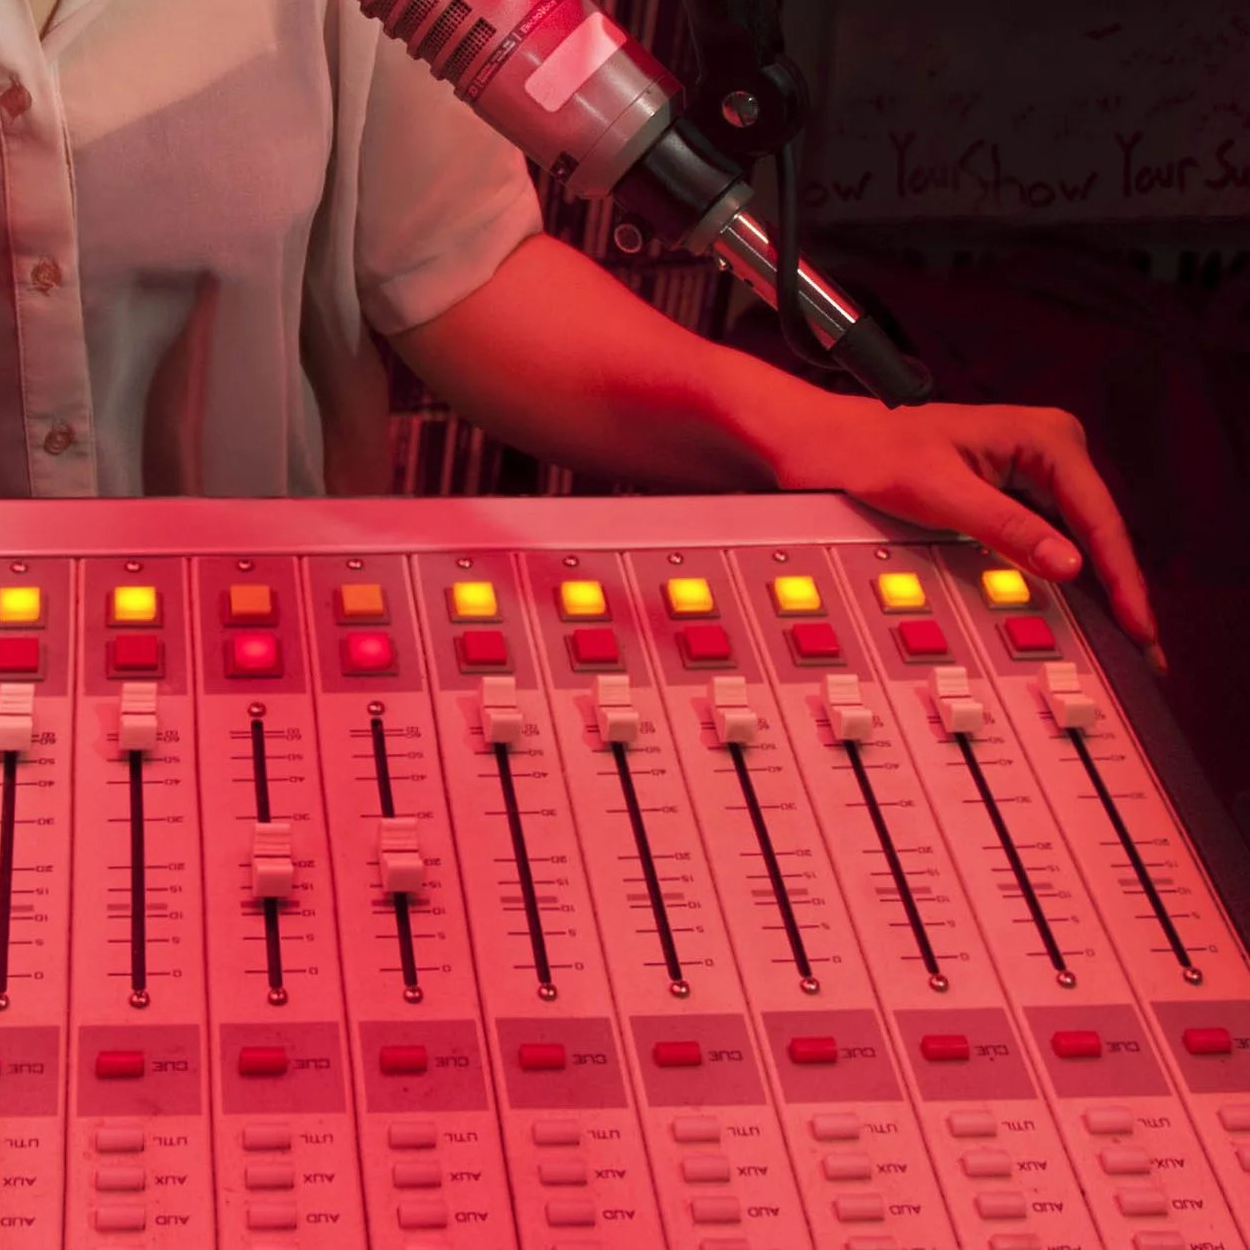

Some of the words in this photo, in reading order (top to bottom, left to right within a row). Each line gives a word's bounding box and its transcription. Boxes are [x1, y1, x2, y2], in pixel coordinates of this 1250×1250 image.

[959, 138, 1098, 208] Show
[1115, 131, 1199, 197] Your
[1204, 137, 1250, 188] Su
[974, 1045, 1009, 1056] CUE
[1106, 1041, 1140, 1053] CUE
[708, 1050, 743, 1062] CUE
[840, 1047, 876, 1059] CUE
[293, 1058, 330, 1070] CUE
[435, 1056, 469, 1067] CUE
[572, 1054, 607, 1066] CUE
[8, 1063, 44, 1074] CUE
[152, 1061, 188, 1072] CUE
[1002, 1121, 1035, 1131] UTIL
[1137, 1117, 1171, 1128] UTIL
[727, 1126, 760, 1137] UTIL
[864, 1124, 898, 1134] UTIL
[299, 1134, 334, 1144] UTIL
[443, 1132, 478, 1142] UTIL
[588, 1130, 620, 1140] UTIL
[5, 1138, 39, 1148] UTIL
[153, 1136, 188, 1146] UTIL
[877, 1164, 907, 1174] AUX
[1017, 1161, 1047, 1171] AUX
[1156, 1158, 1184, 1169] AUX
[595, 1169, 626, 1179] AUX
[737, 1166, 768, 1176] AUX
[3, 1177, 36, 1187] AUX
[155, 1176, 187, 1185] AUX
[303, 1173, 335, 1183] AUX
[450, 1172, 481, 1182] AUX
[889, 1205, 921, 1215] AUD
[1032, 1202, 1063, 1213] AUD
[1172, 1199, 1203, 1210] AUD
[455, 1212, 488, 1223] AUD
[602, 1209, 635, 1220] AUD
[747, 1207, 779, 1218] AUD
[0, 1217, 35, 1227] AUD
[155, 1215, 190, 1225] AUD
[306, 1213, 340, 1224] AUD
